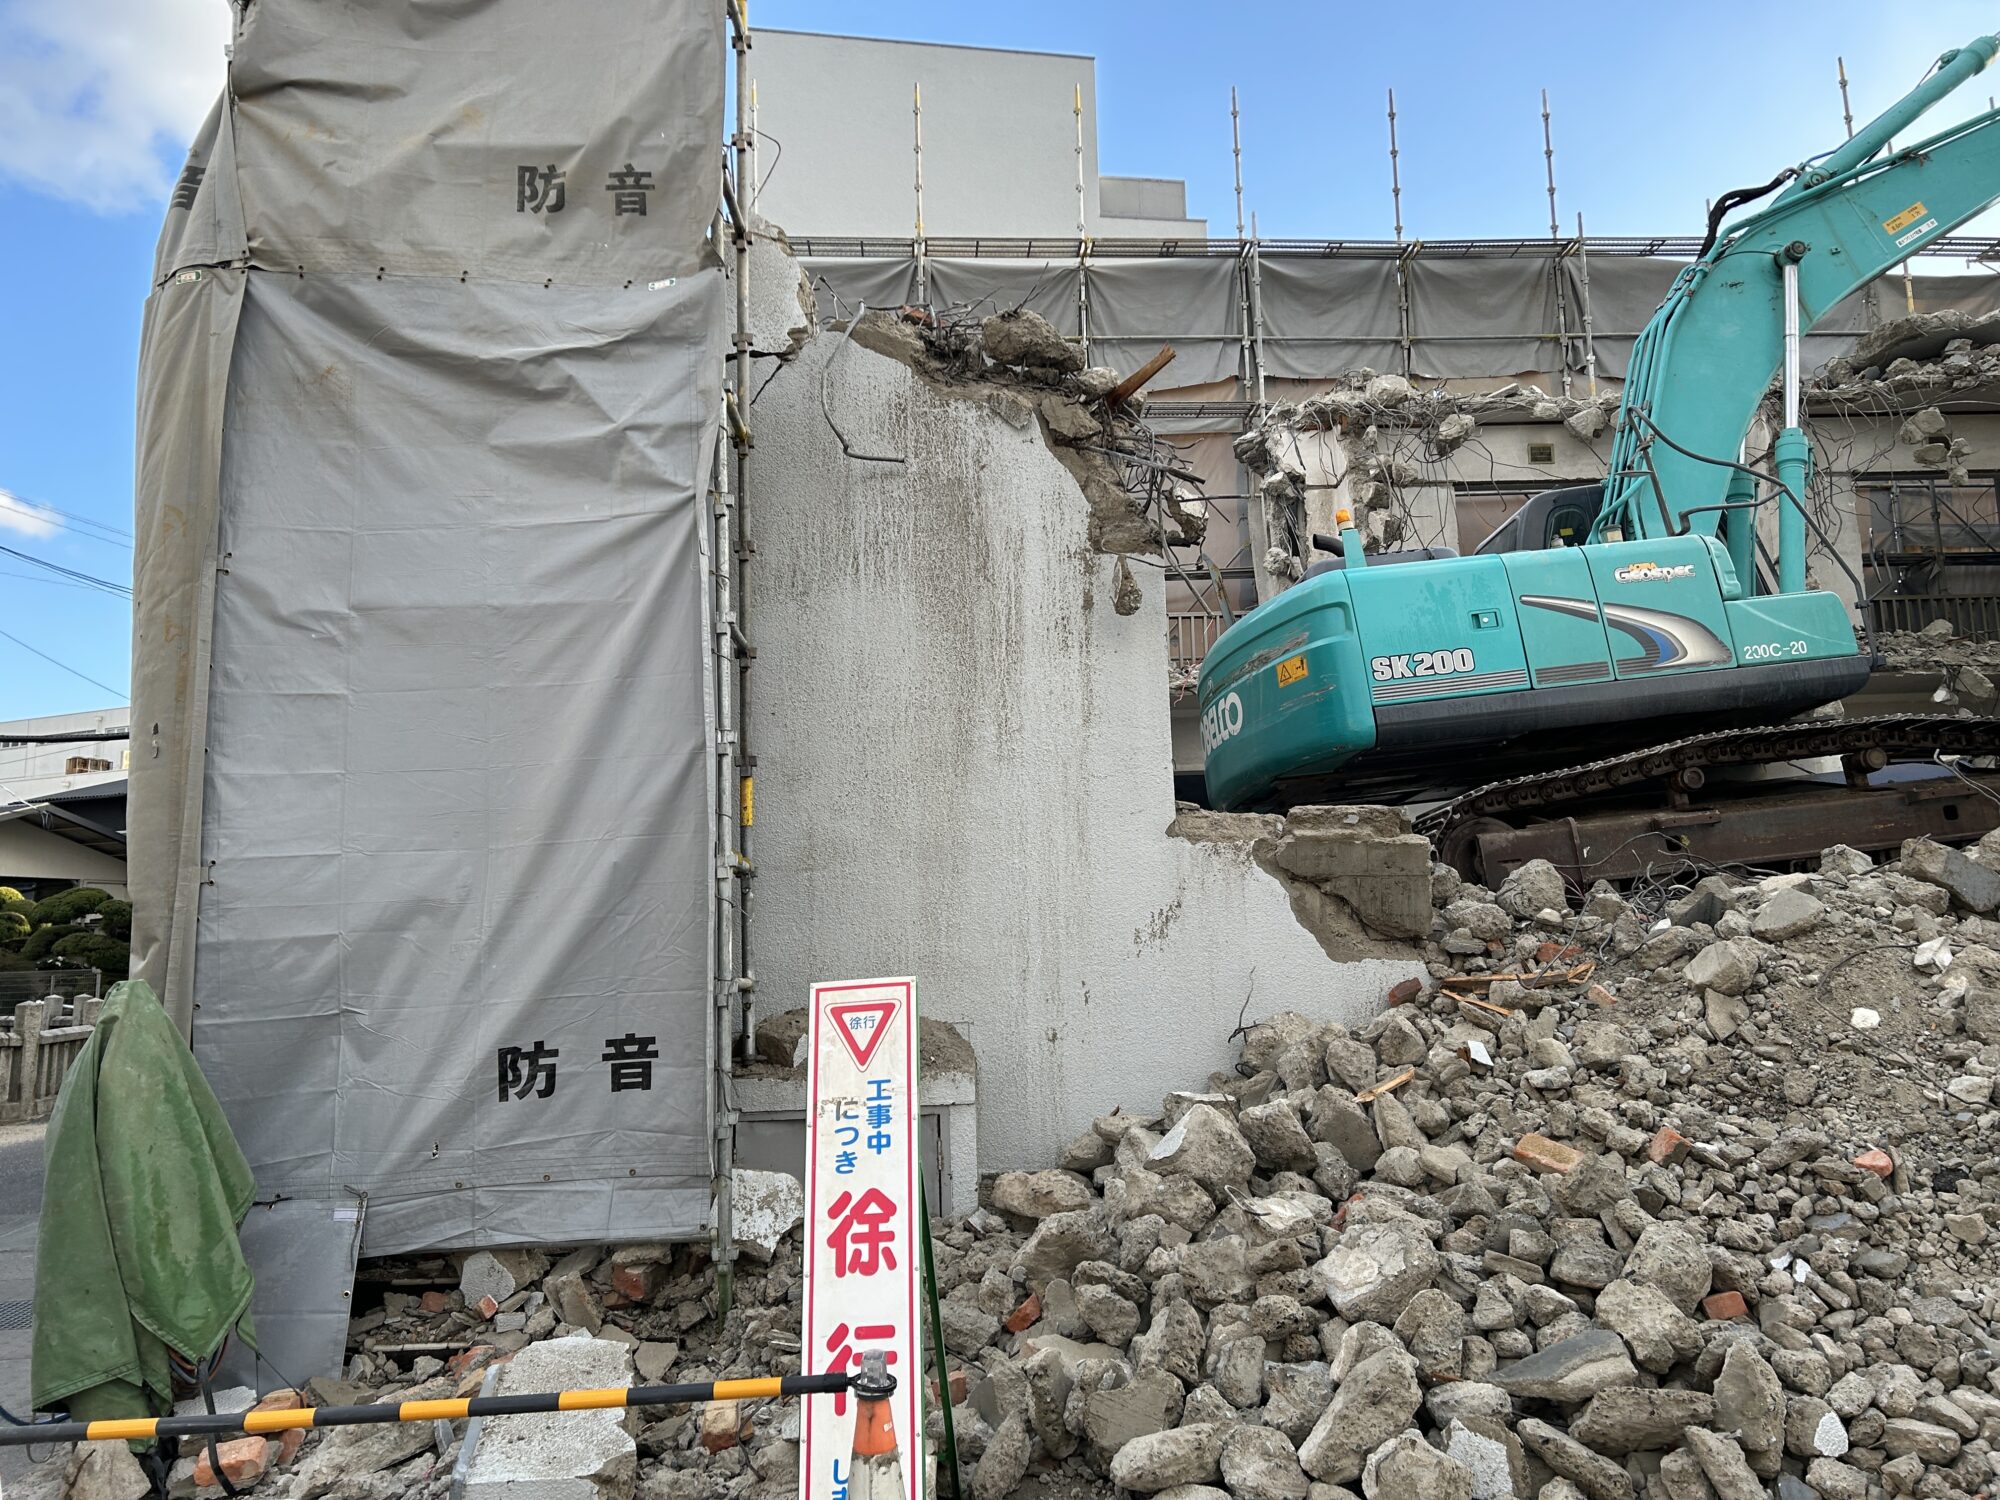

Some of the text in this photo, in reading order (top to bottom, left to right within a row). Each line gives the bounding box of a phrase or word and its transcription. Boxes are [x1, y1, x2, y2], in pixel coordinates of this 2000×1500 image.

[516, 163, 655, 217] 防音
[1371, 648, 1475, 682] SK200
[1743, 640, 1808, 660] 200C-20
[849, 1015, 877, 1030] 徐行
[498, 1033, 658, 1102] 防音
[834, 1100, 859, 1174] につき
[866, 1079, 892, 1155] 工事中
[826, 1187, 898, 1417] 徐行
